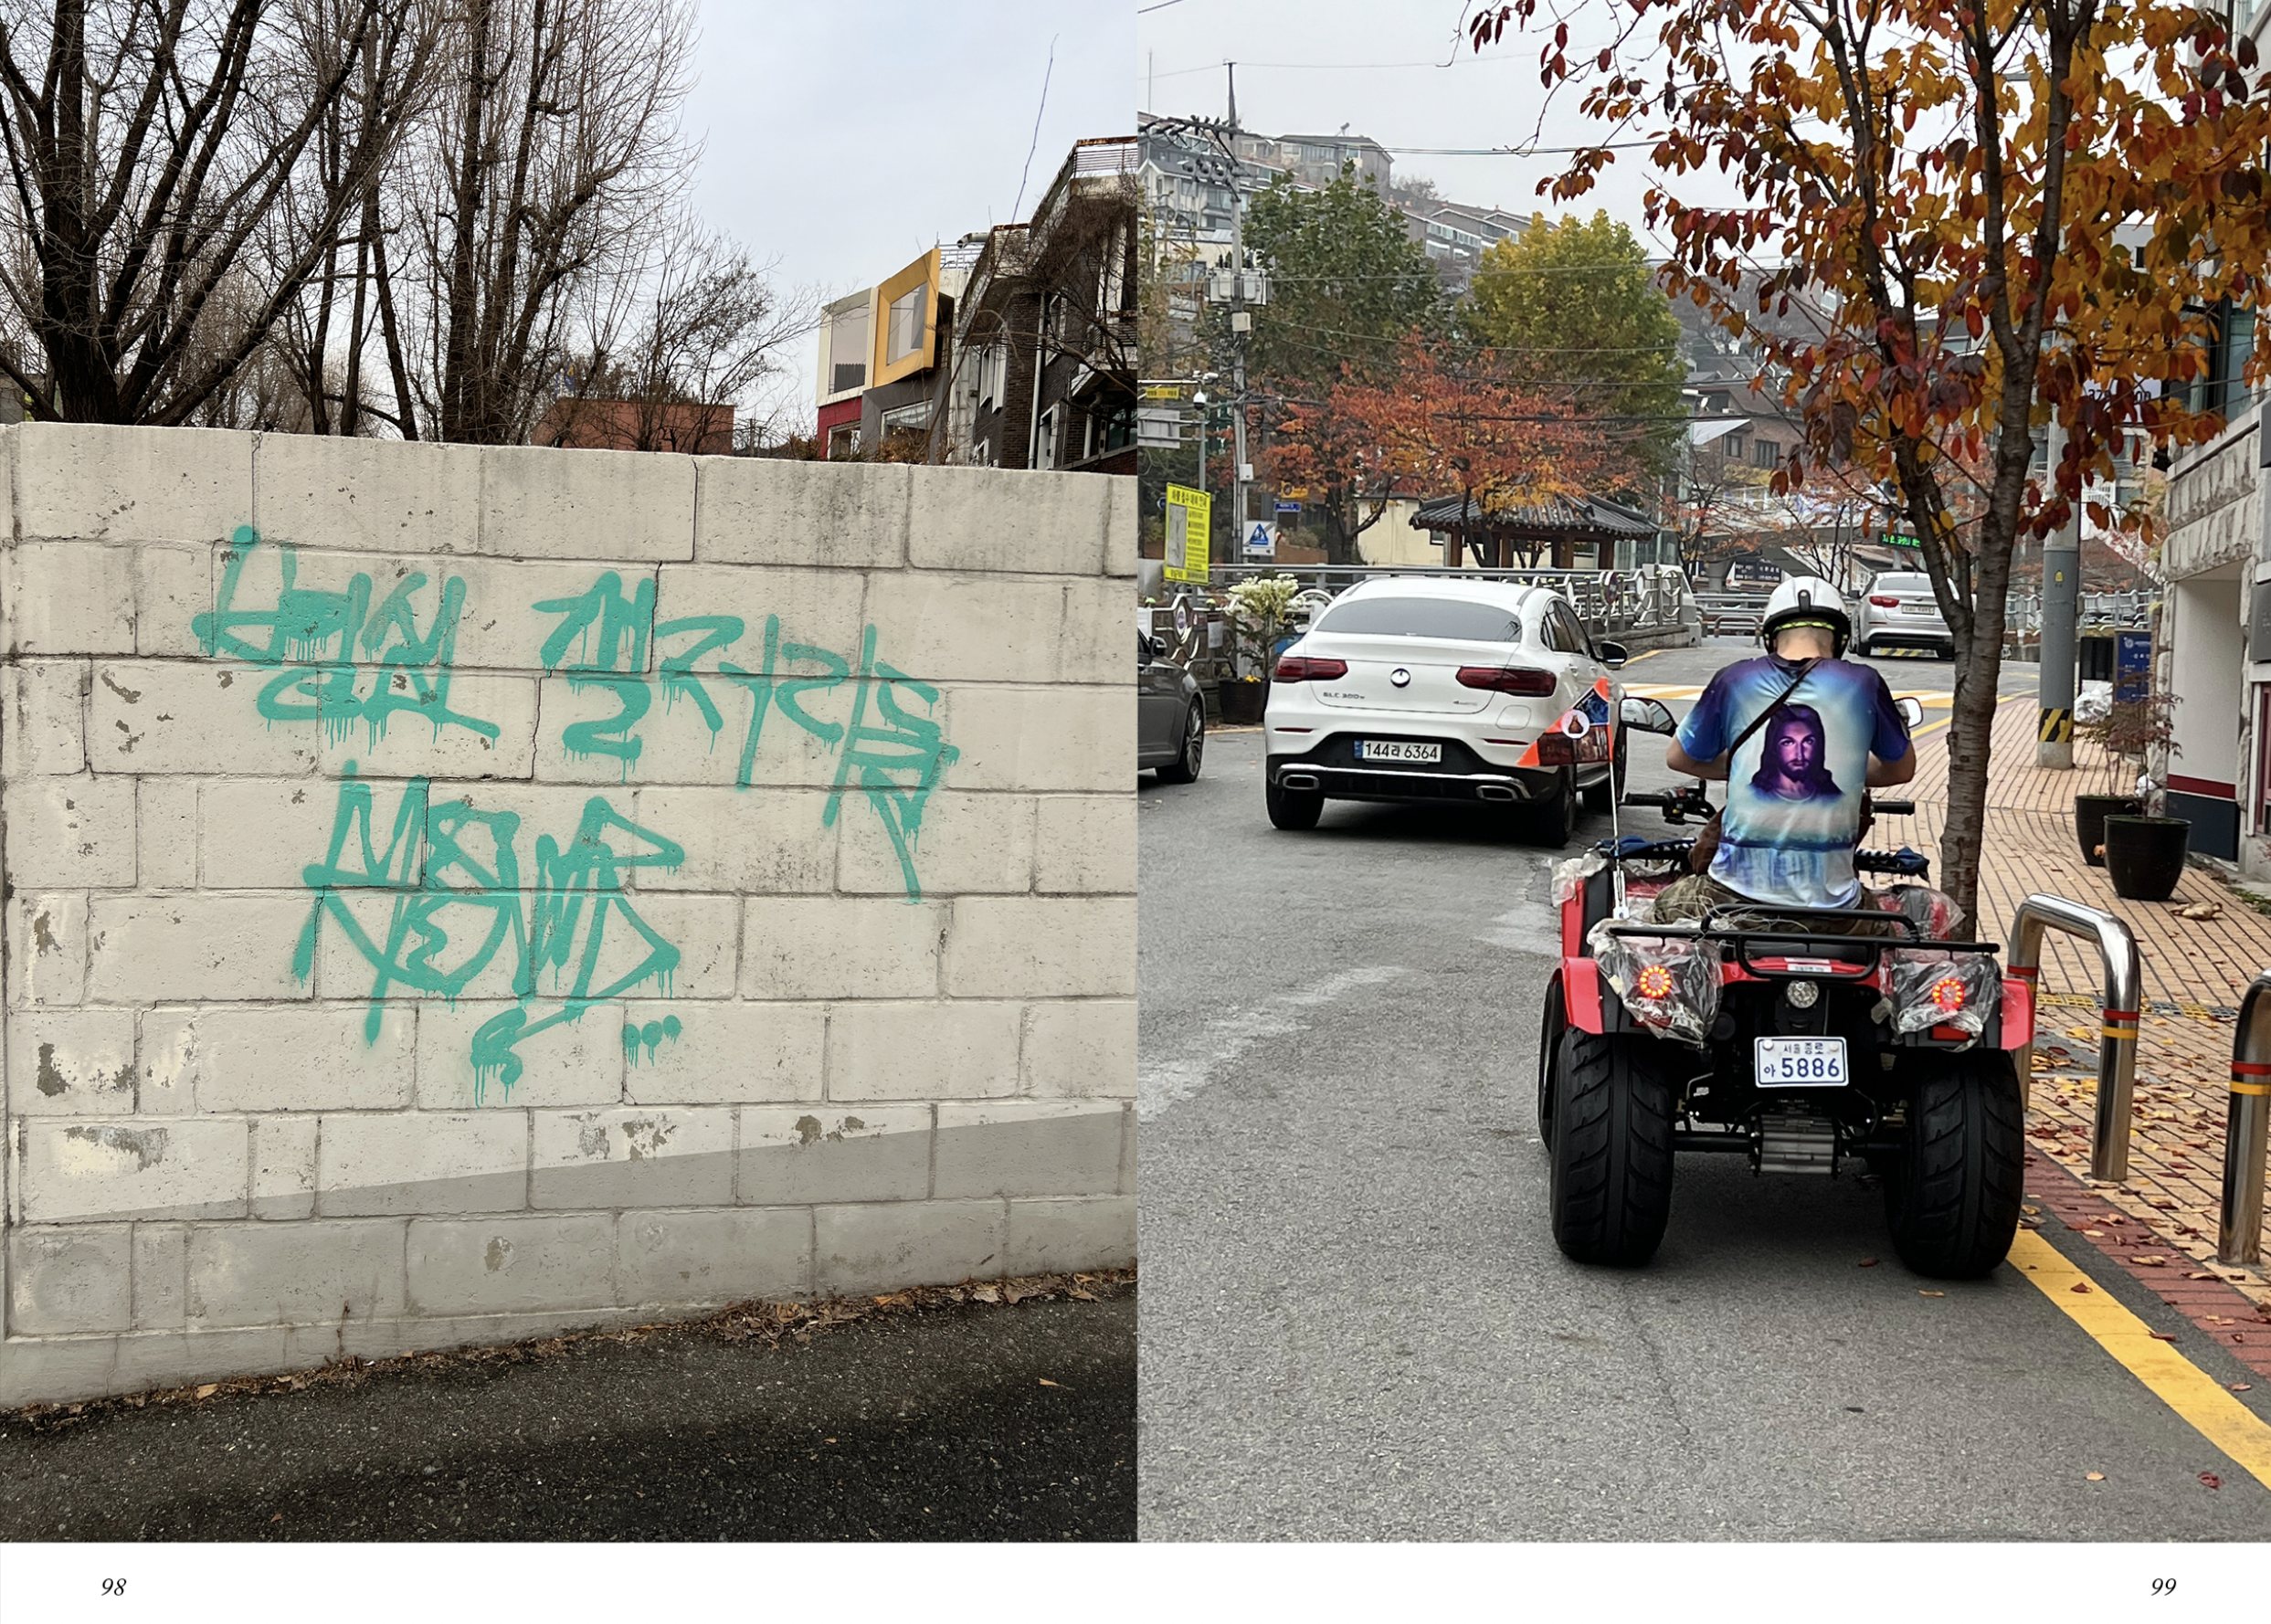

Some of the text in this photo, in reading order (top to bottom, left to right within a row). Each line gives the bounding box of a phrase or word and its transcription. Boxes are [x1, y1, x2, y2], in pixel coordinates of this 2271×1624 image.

[1365, 743, 1438, 760] 144라 6364
[1781, 1057, 1840, 1078] 5886
